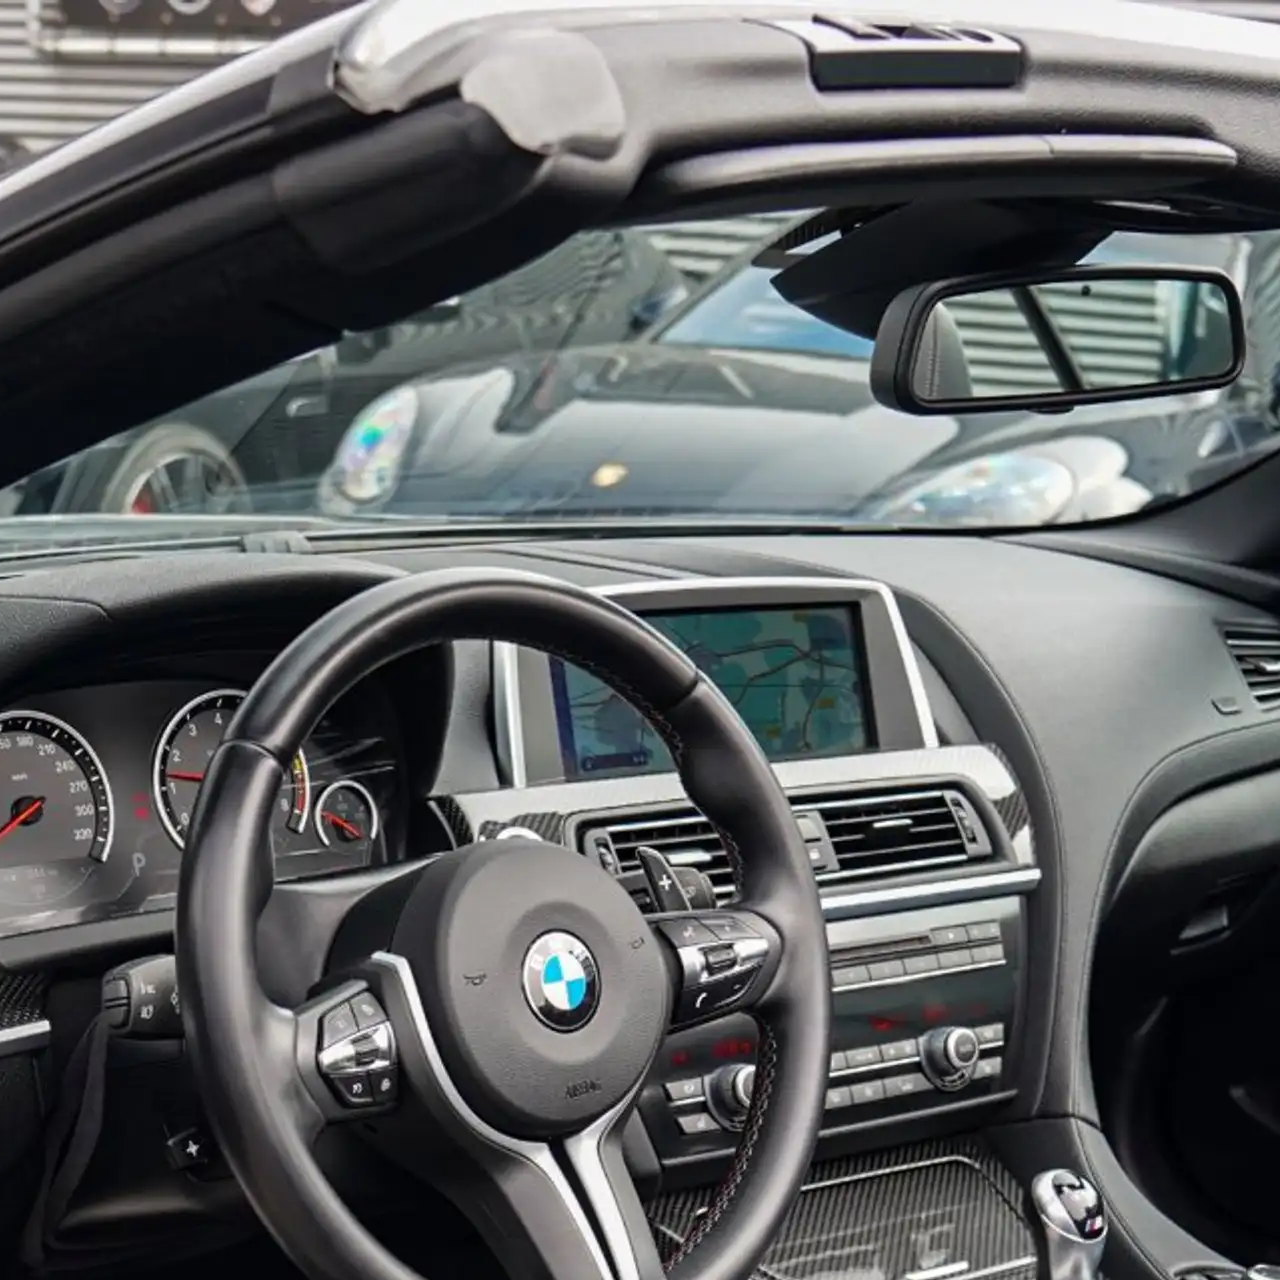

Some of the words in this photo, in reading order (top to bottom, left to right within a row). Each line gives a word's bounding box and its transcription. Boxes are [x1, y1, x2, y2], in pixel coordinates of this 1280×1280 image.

[214, 713, 222, 724] 4
[188, 724, 197, 735] 3
[16, 736, 34, 747] 180
[38, 744, 56, 756] 210
[173, 751, 181, 762] 2
[55, 760, 76, 773] 240
[69, 781, 88, 793] 270
[170, 783, 177, 794] 1
[75, 804, 94, 816] 300
[280, 798, 289, 812] 8
[181, 813, 190, 825] 0
[73, 829, 93, 840] 330
